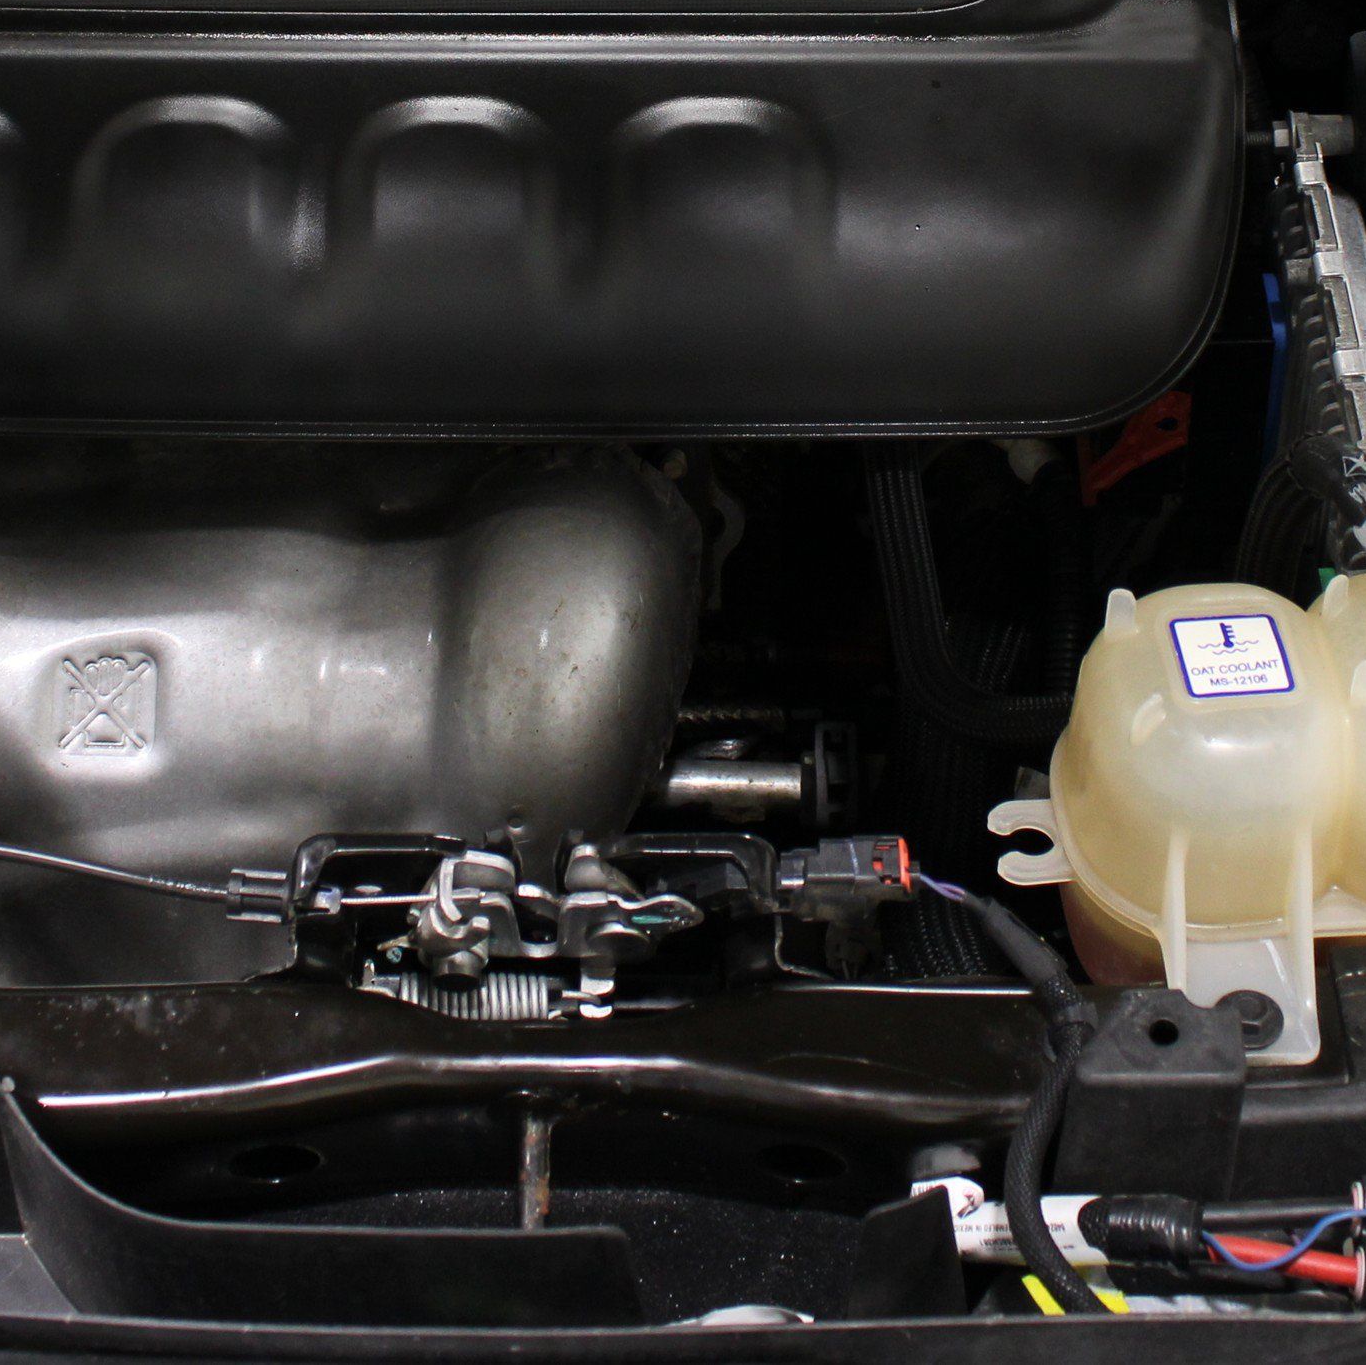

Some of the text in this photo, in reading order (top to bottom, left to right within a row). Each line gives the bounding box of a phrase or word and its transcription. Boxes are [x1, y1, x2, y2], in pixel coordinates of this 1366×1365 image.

[1191, 659, 1279, 676] OAT COOLANT
[1209, 674, 1268, 686] MS-12106
